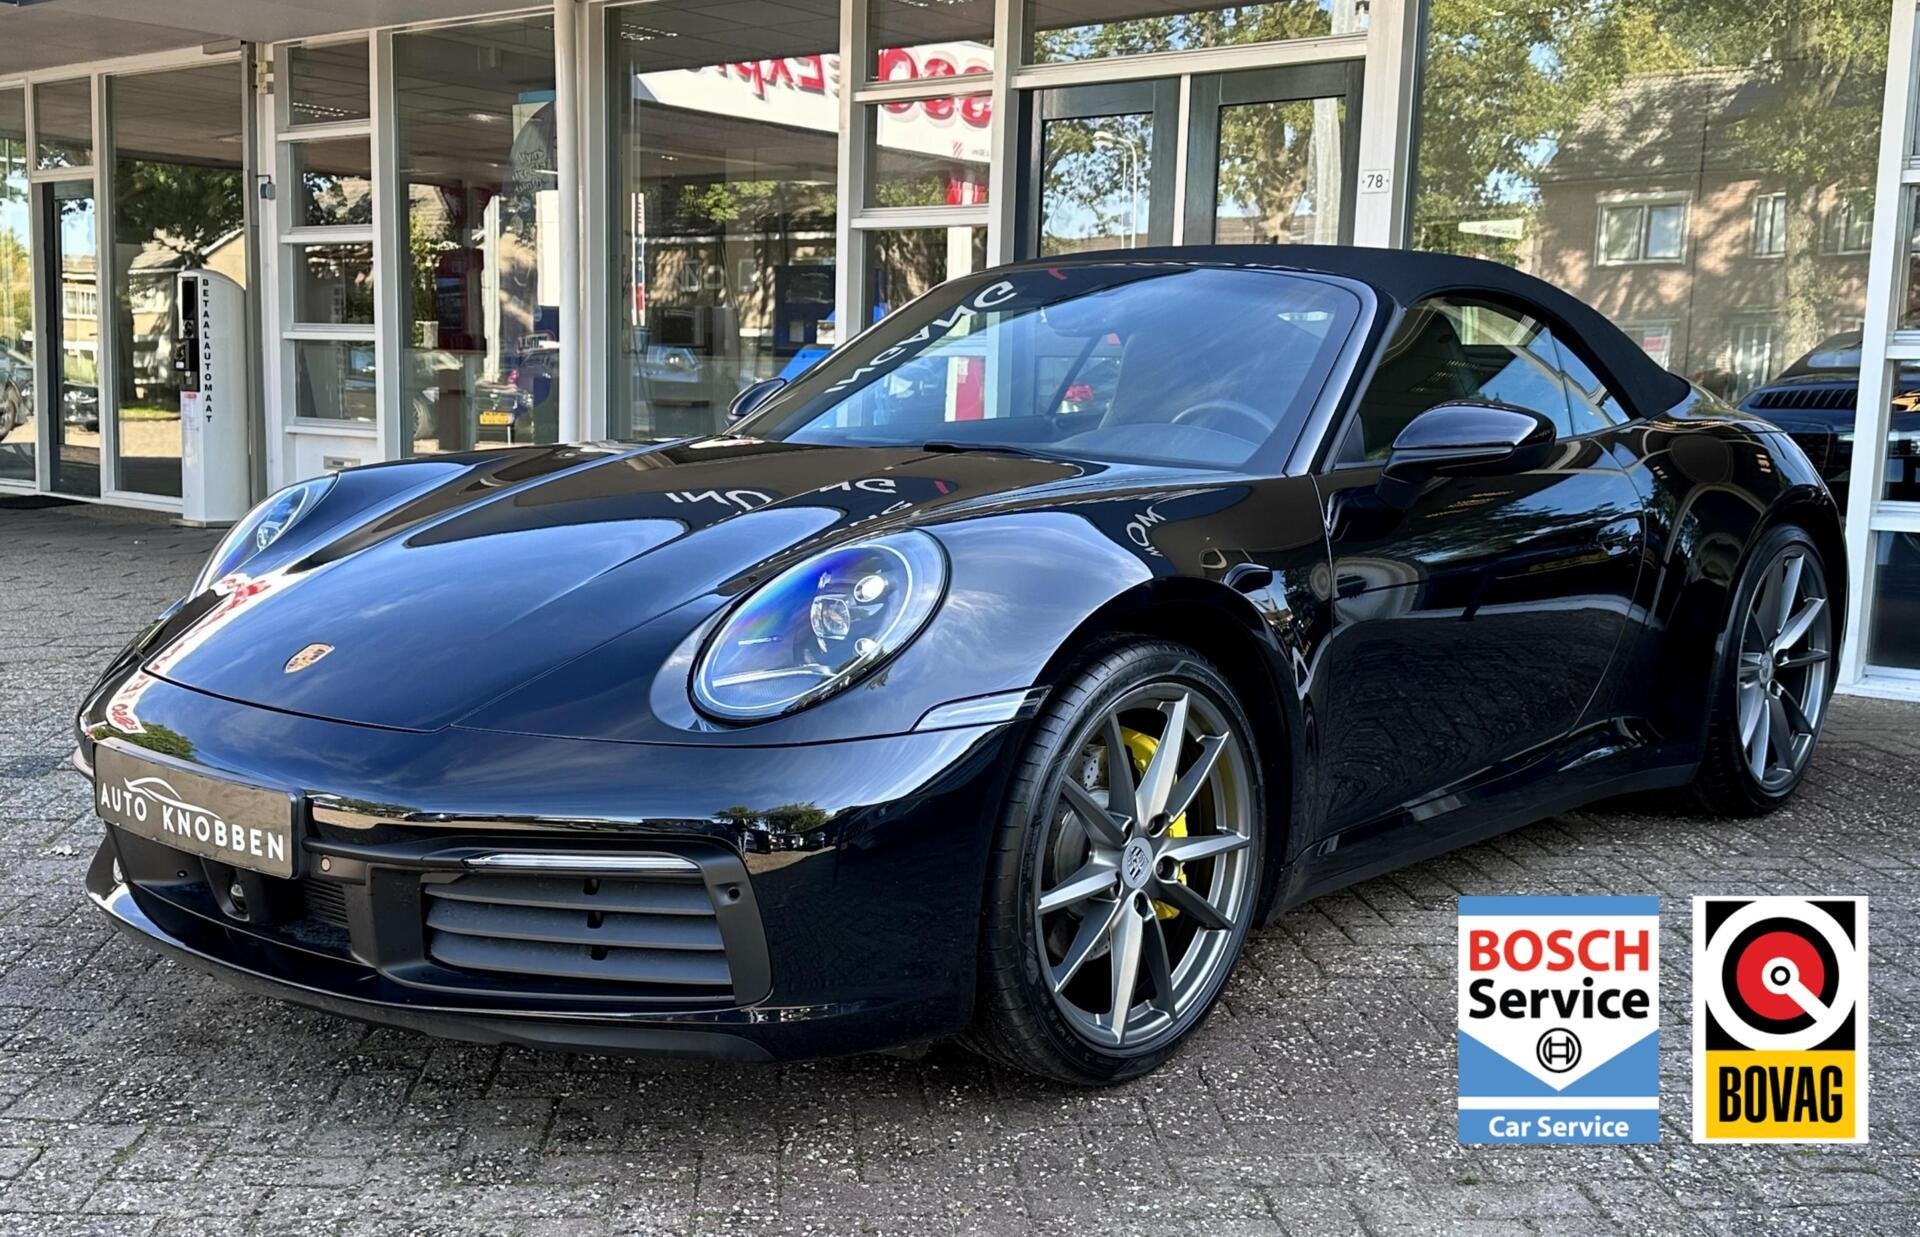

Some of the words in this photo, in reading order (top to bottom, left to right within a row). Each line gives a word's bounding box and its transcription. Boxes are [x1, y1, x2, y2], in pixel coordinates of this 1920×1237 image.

[1367, 174, 1383, 189] 78
[202, 278, 213, 423] BETAALAUTOMAAT
[101, 783, 147, 822] AUTO
[162, 804, 284, 862] KNOBBEN
